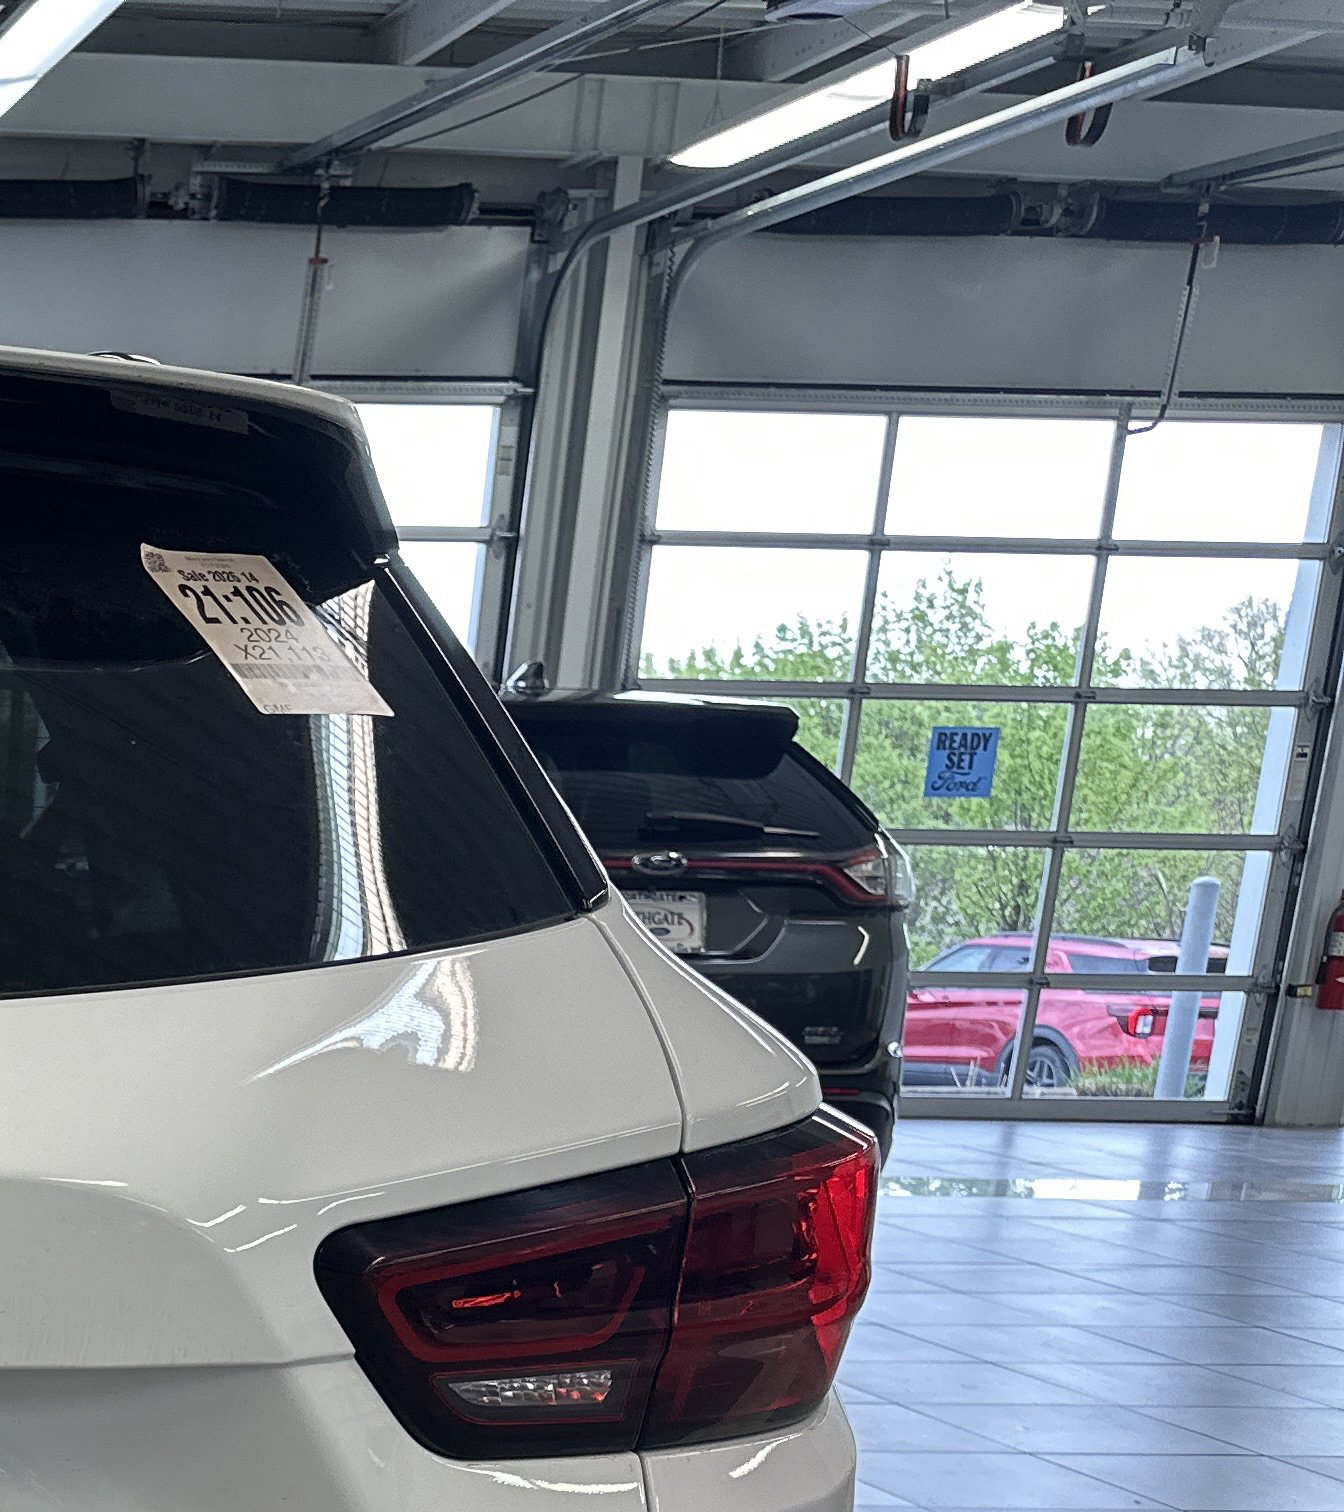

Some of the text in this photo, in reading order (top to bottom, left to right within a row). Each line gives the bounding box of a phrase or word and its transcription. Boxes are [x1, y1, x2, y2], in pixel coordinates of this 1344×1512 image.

[177, 569, 209, 582] Sale
[241, 571, 260, 584] 14
[177, 583, 305, 627] 21:106
[240, 627, 300, 644] 2024
[936, 731, 993, 752] READY
[944, 751, 978, 770] SET
[930, 770, 983, 793] Ford
